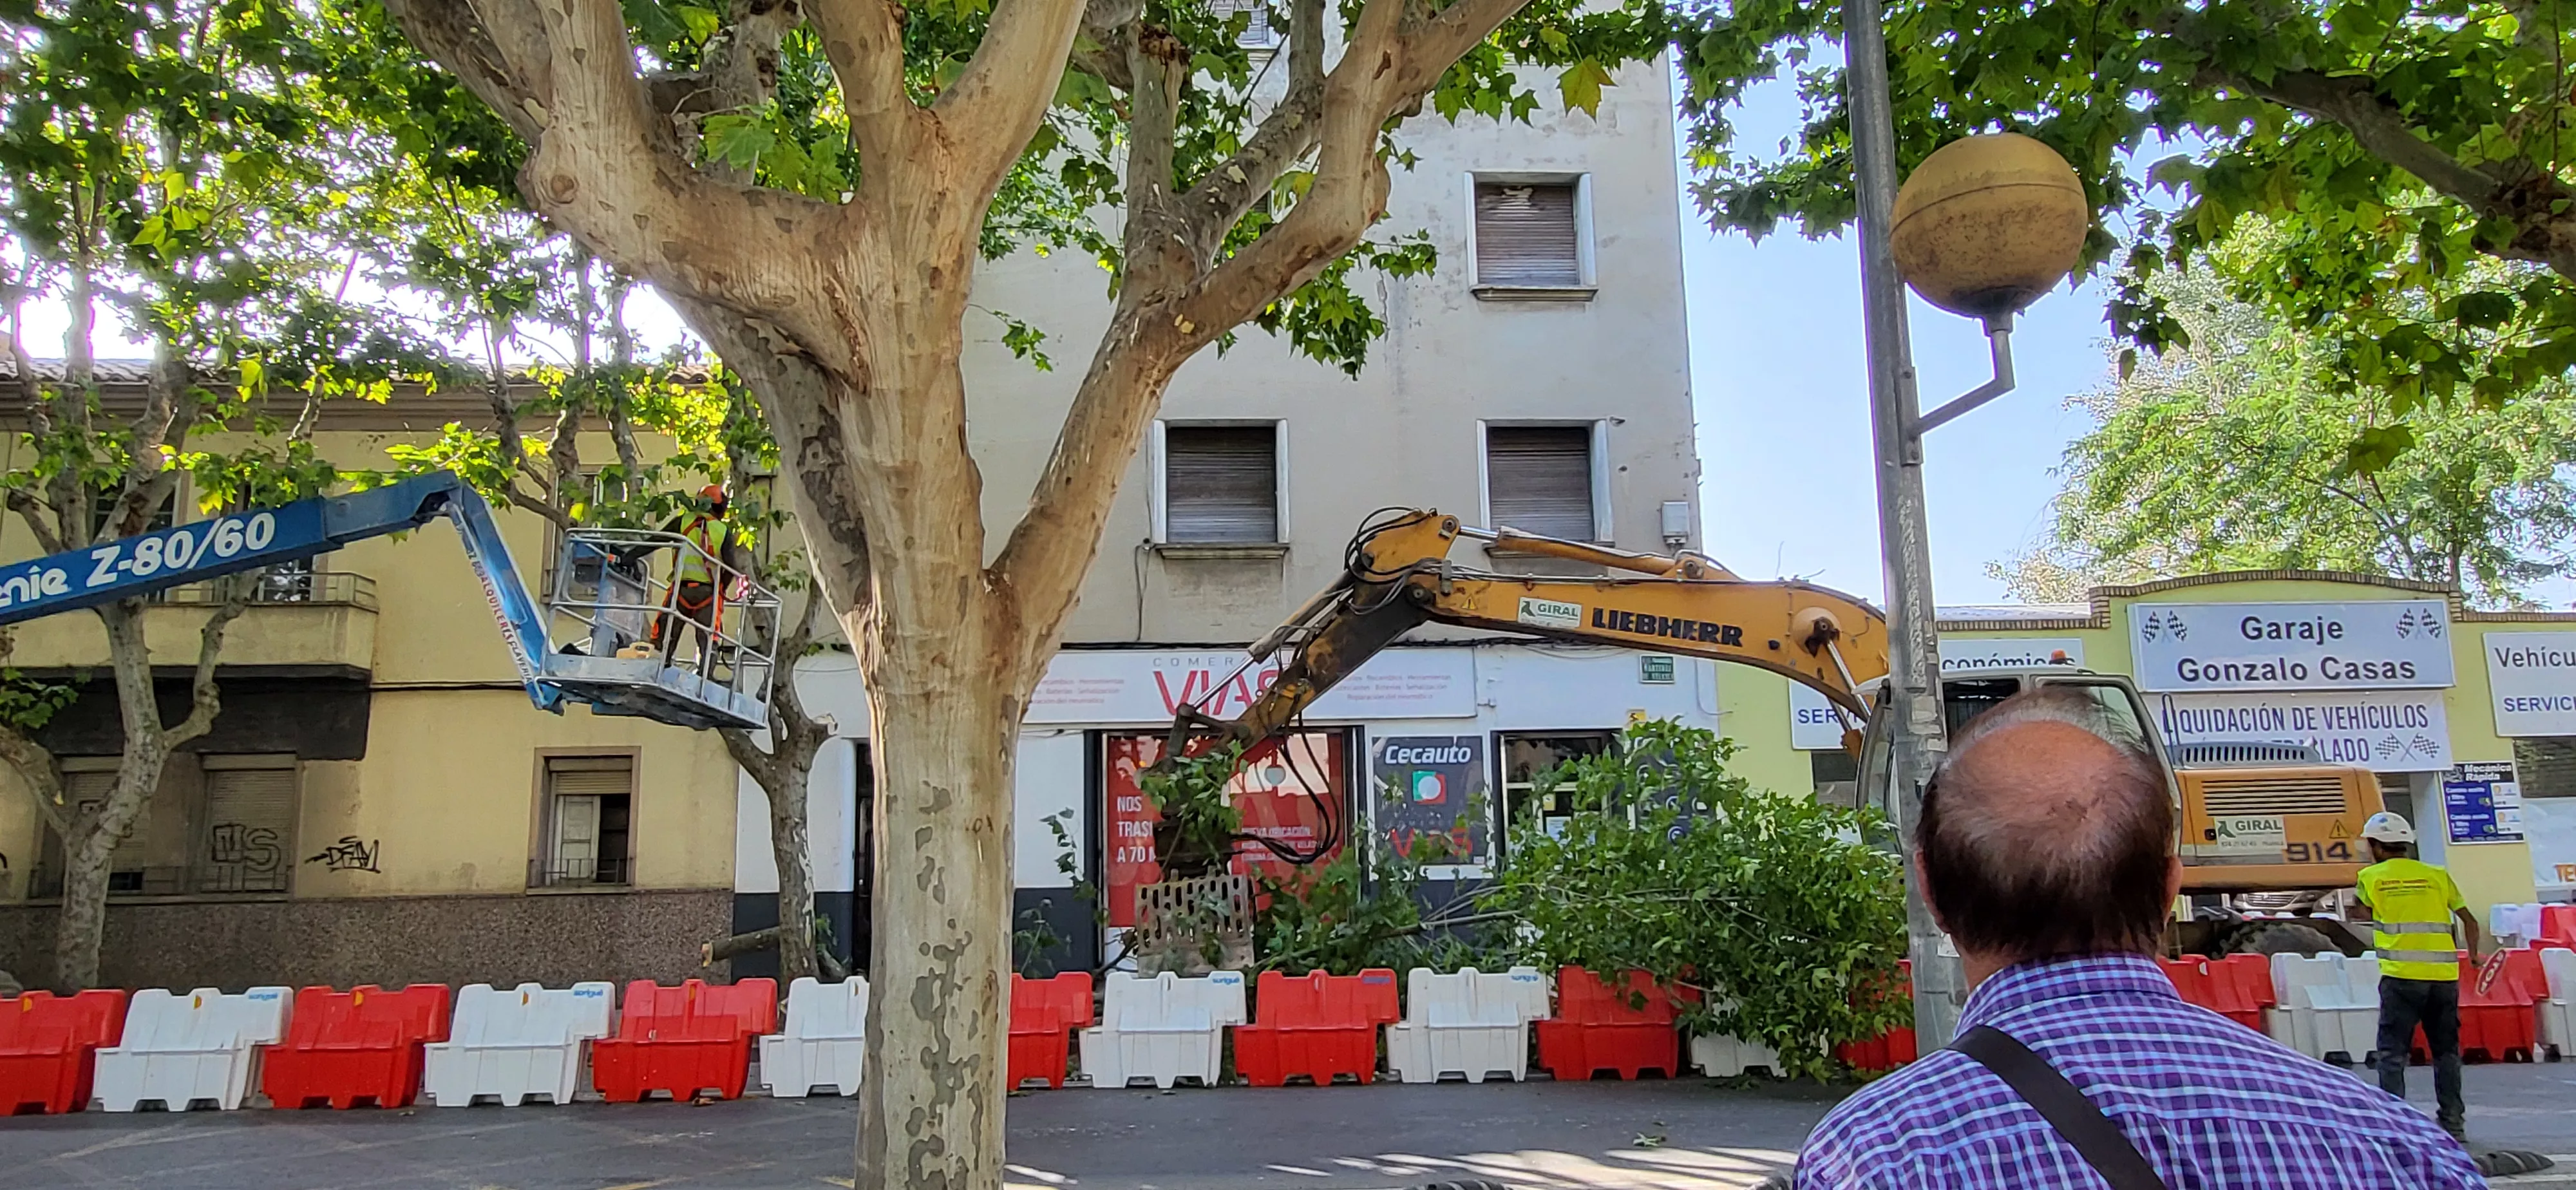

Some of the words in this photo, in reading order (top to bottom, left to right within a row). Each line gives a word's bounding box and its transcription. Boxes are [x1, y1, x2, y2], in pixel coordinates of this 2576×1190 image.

[86, 512, 276, 588] Z-80/60
[1537, 603, 1578, 618] GIRAL
[1591, 607, 1743, 647] LIEBHERR
[2240, 615, 2344, 645] Garaje
[2177, 657, 2308, 683] Gonzalo
[2320, 657, 2416, 680] Casas
[2292, 707, 2318, 732] DE
[2322, 701, 2429, 730] VEHÍCULOS
[1385, 745, 1472, 764] Cecauto
[1117, 796, 1142, 812] NOS
[2235, 819, 2282, 831] GIRAL
[1117, 846, 1126, 863] A
[1129, 846, 1146, 863] 70
[2287, 841, 2353, 862] 914
